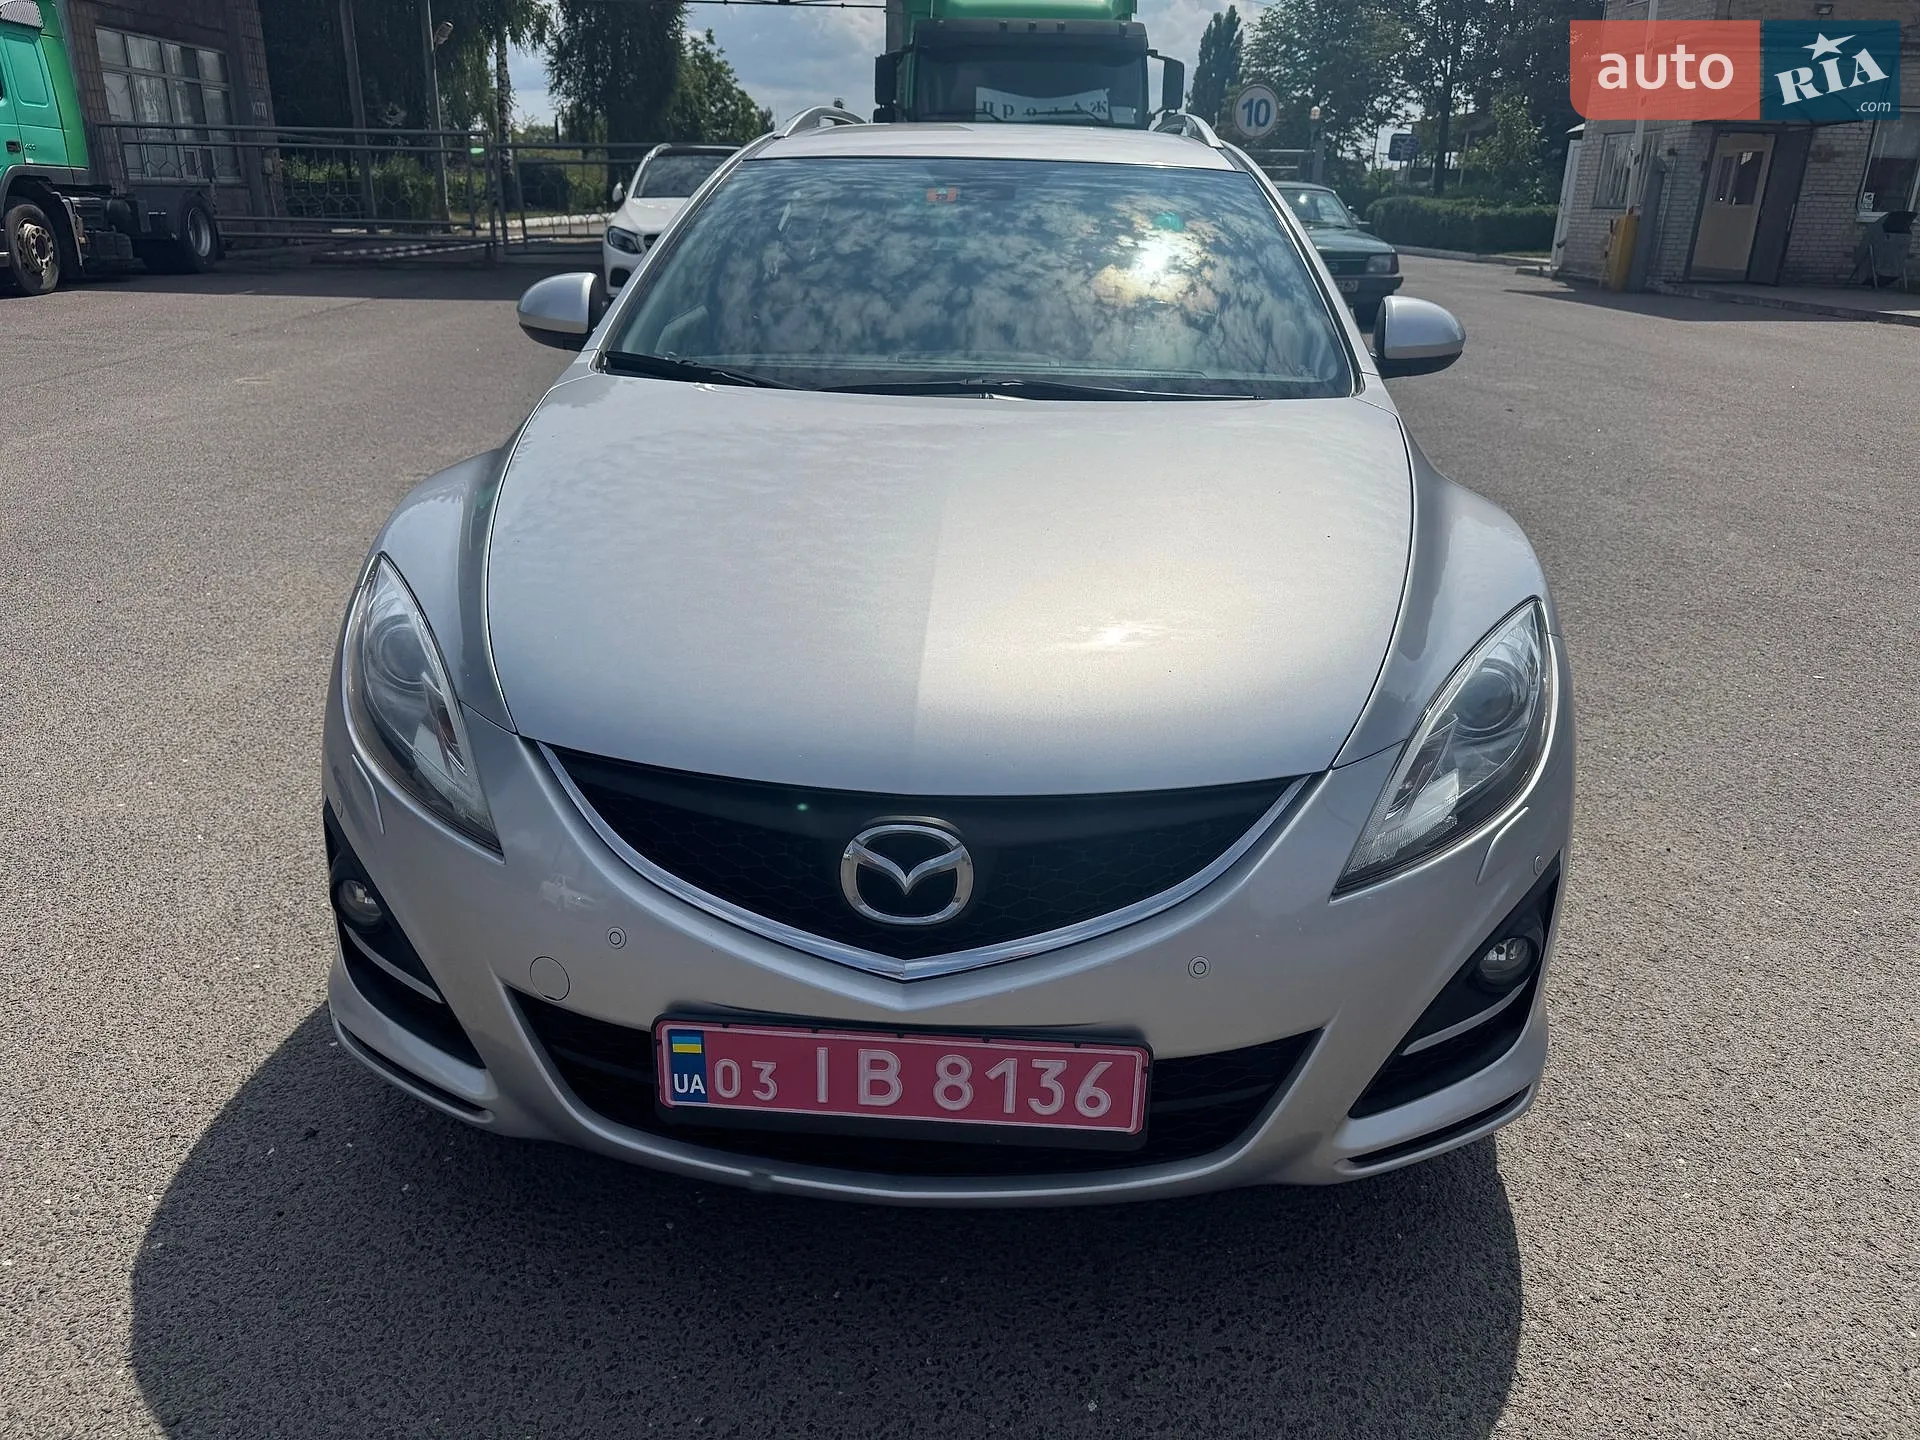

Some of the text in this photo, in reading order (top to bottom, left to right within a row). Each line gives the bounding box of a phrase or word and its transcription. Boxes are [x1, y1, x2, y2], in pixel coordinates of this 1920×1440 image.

[1242, 98, 1271, 128] 10
[673, 1074, 706, 1095] UA
[714, 1058, 778, 1101] 03
[932, 1053, 1113, 1119] 8136
